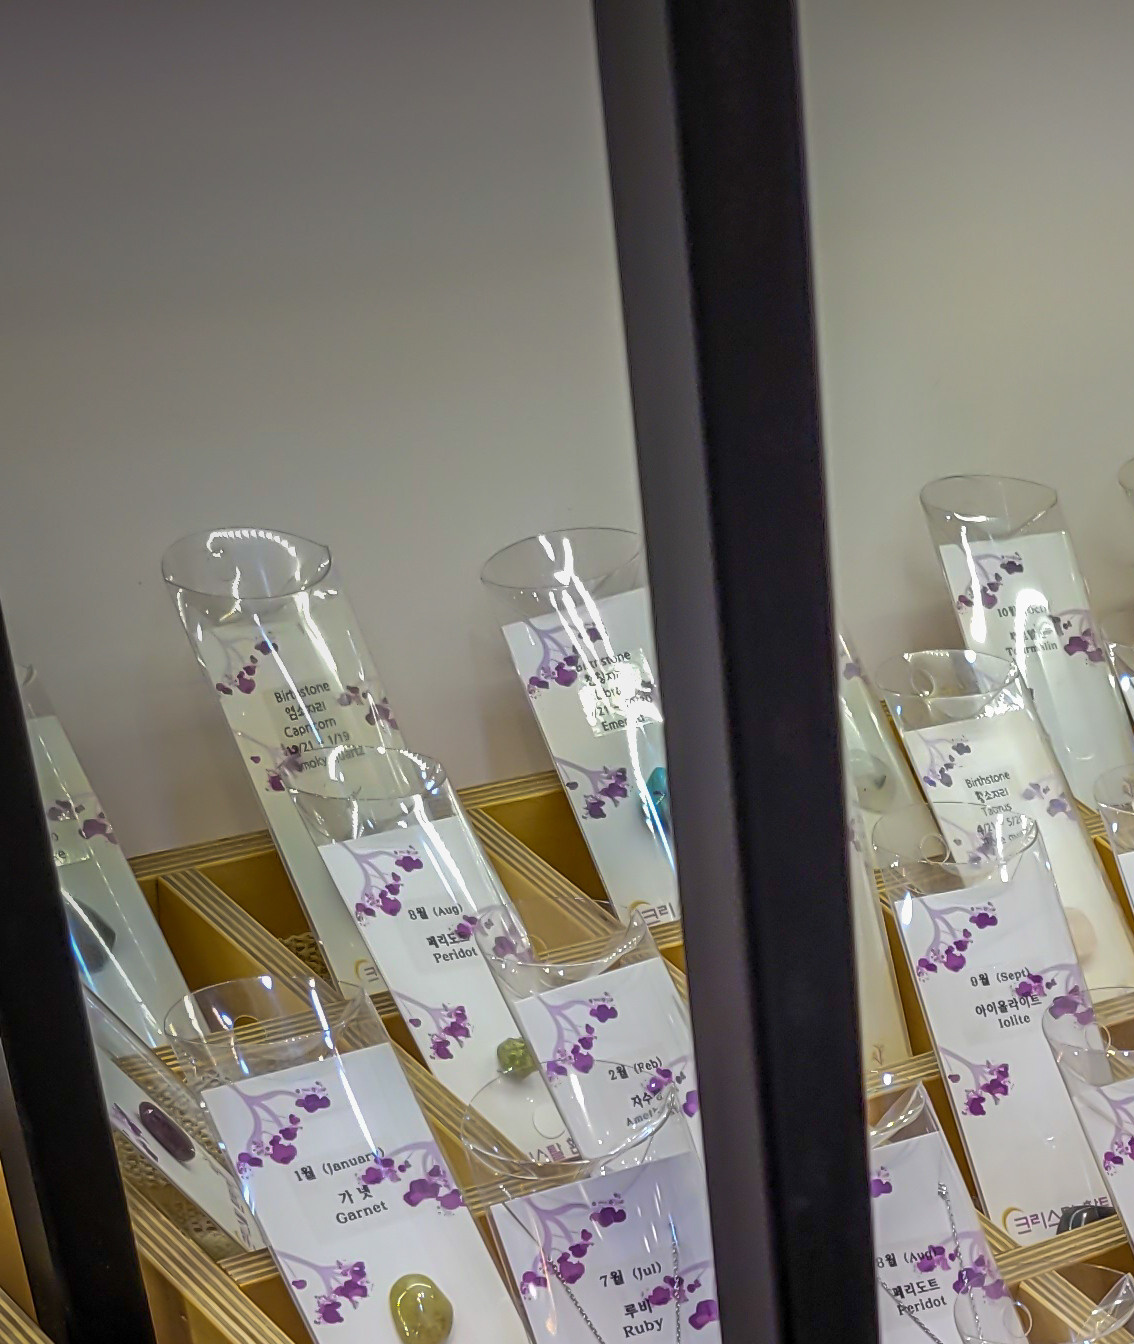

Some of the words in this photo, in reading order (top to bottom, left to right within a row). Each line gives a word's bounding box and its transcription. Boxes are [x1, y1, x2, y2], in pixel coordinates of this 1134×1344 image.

[408, 906, 429, 920] 8월
[433, 903, 464, 917] (Aug)
[433, 946, 478, 963] Peridot
[996, 966, 1031, 983] (Sept)
[974, 994, 1043, 1017] 아이올라이트
[998, 1014, 1031, 1029] Iolite
[608, 1064, 629, 1081] 2월
[634, 1056, 663, 1075] (Feb)
[294, 1164, 316, 1182] 1월
[321, 1146, 387, 1182] (January)
[335, 1200, 389, 1226] Garnet
[876, 1251, 898, 1269] 8월
[903, 1247, 938, 1265] (Aug)
[599, 1268, 625, 1289] 7월
[631, 1260, 663, 1282] (Jul)
[891, 1277, 941, 1300] 페리도트
[623, 1298, 655, 1321] 루비
[897, 1294, 947, 1316] Peridot
[623, 1315, 665, 1340] Ruby
